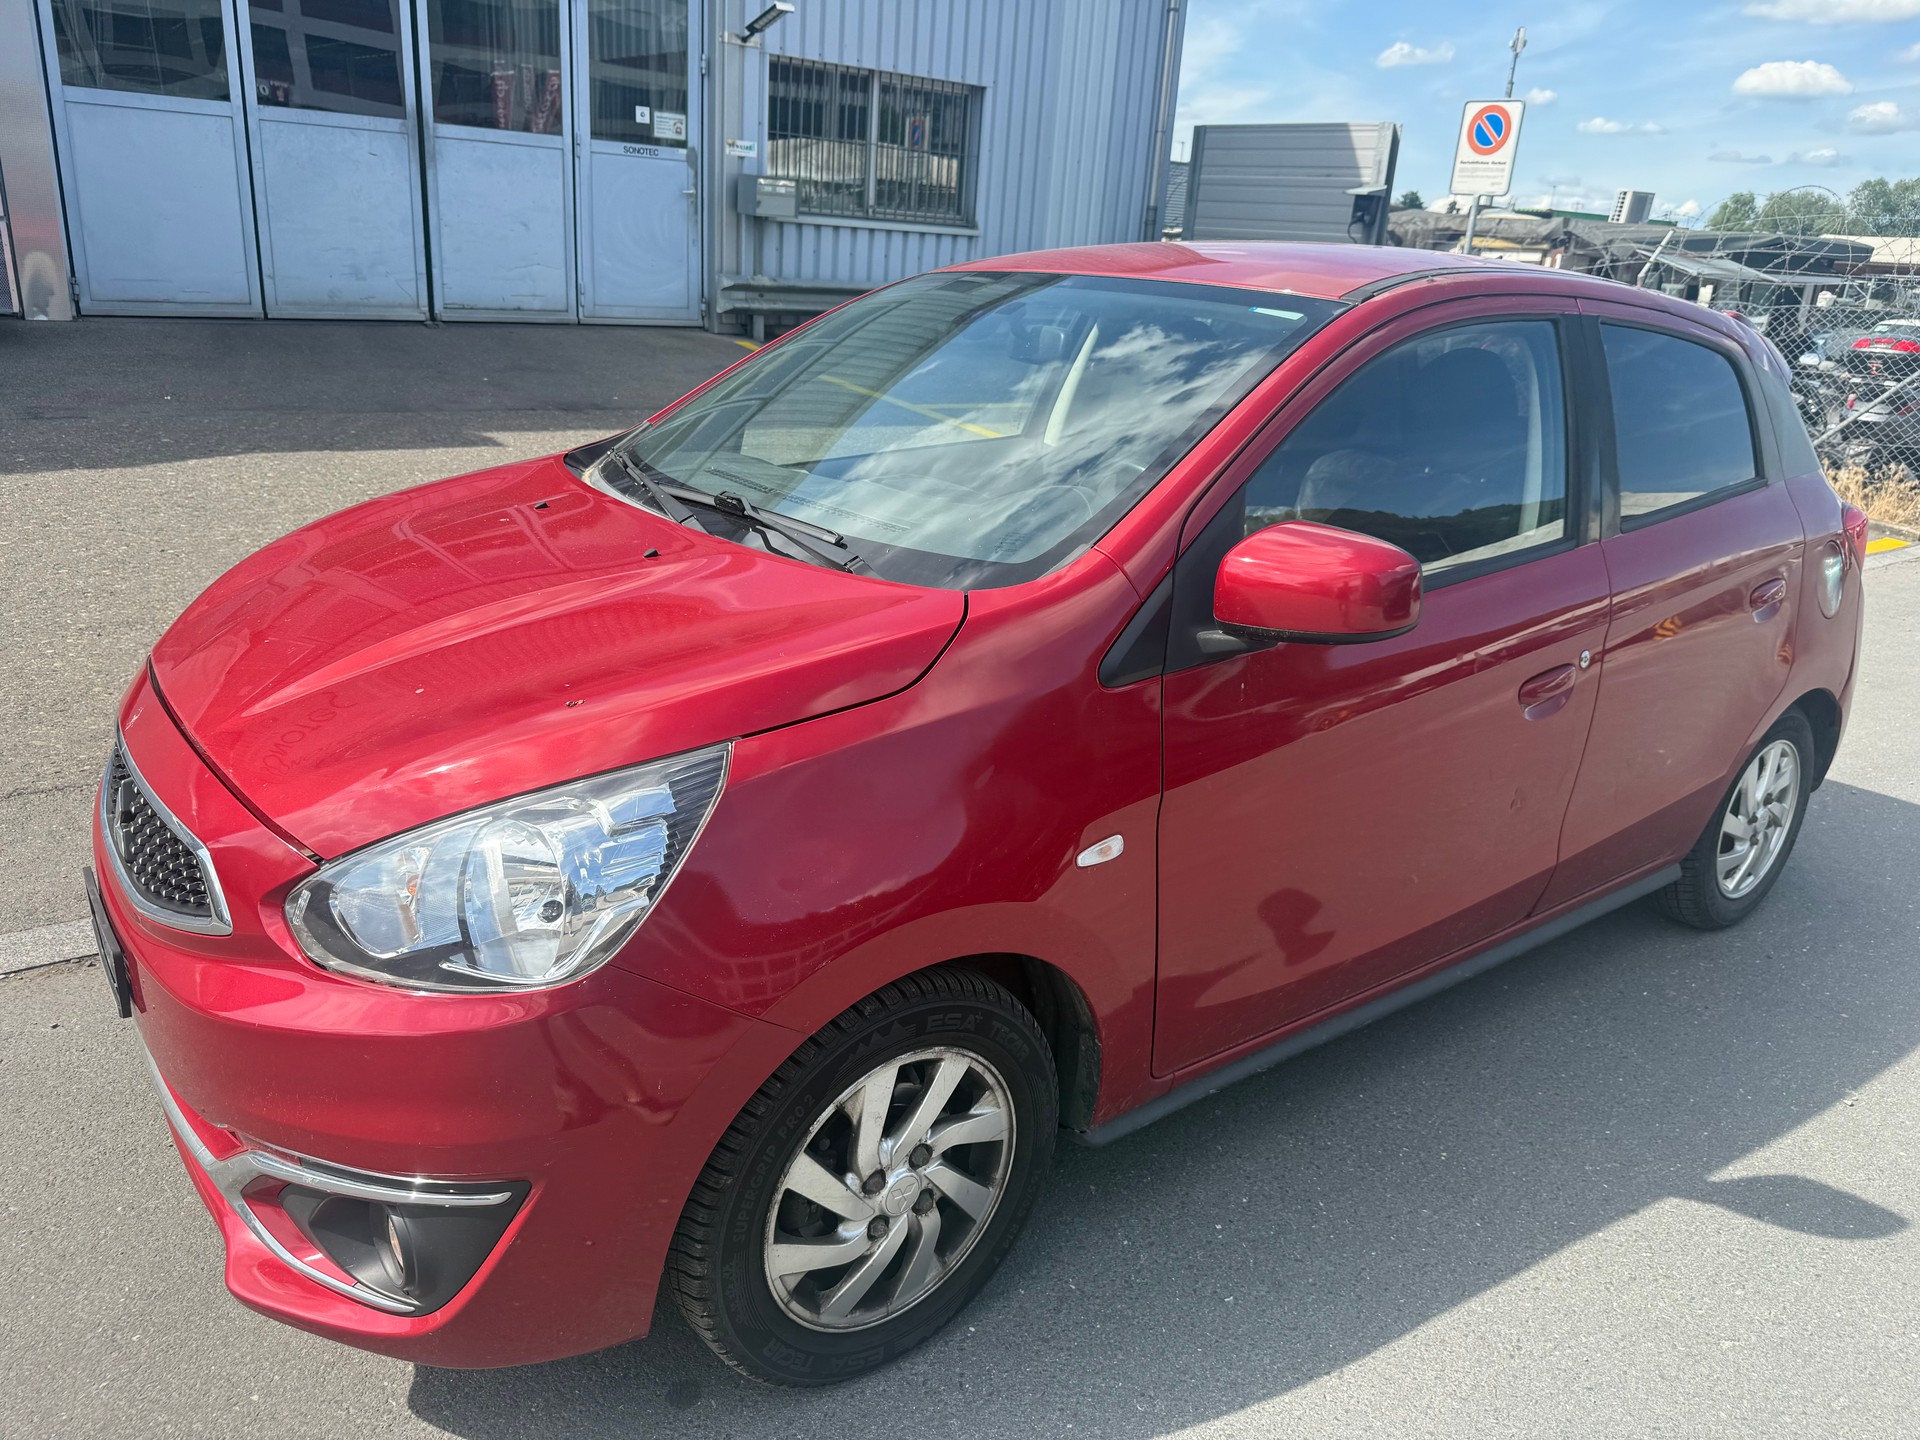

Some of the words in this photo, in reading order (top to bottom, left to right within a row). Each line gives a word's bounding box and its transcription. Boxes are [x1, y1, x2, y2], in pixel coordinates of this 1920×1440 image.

[623, 145, 659, 157] SONOTEC
[732, 1144, 776, 1243] SUPERGRIP
[777, 1108, 805, 1140] PRO
[806, 1094, 816, 1109] 2
